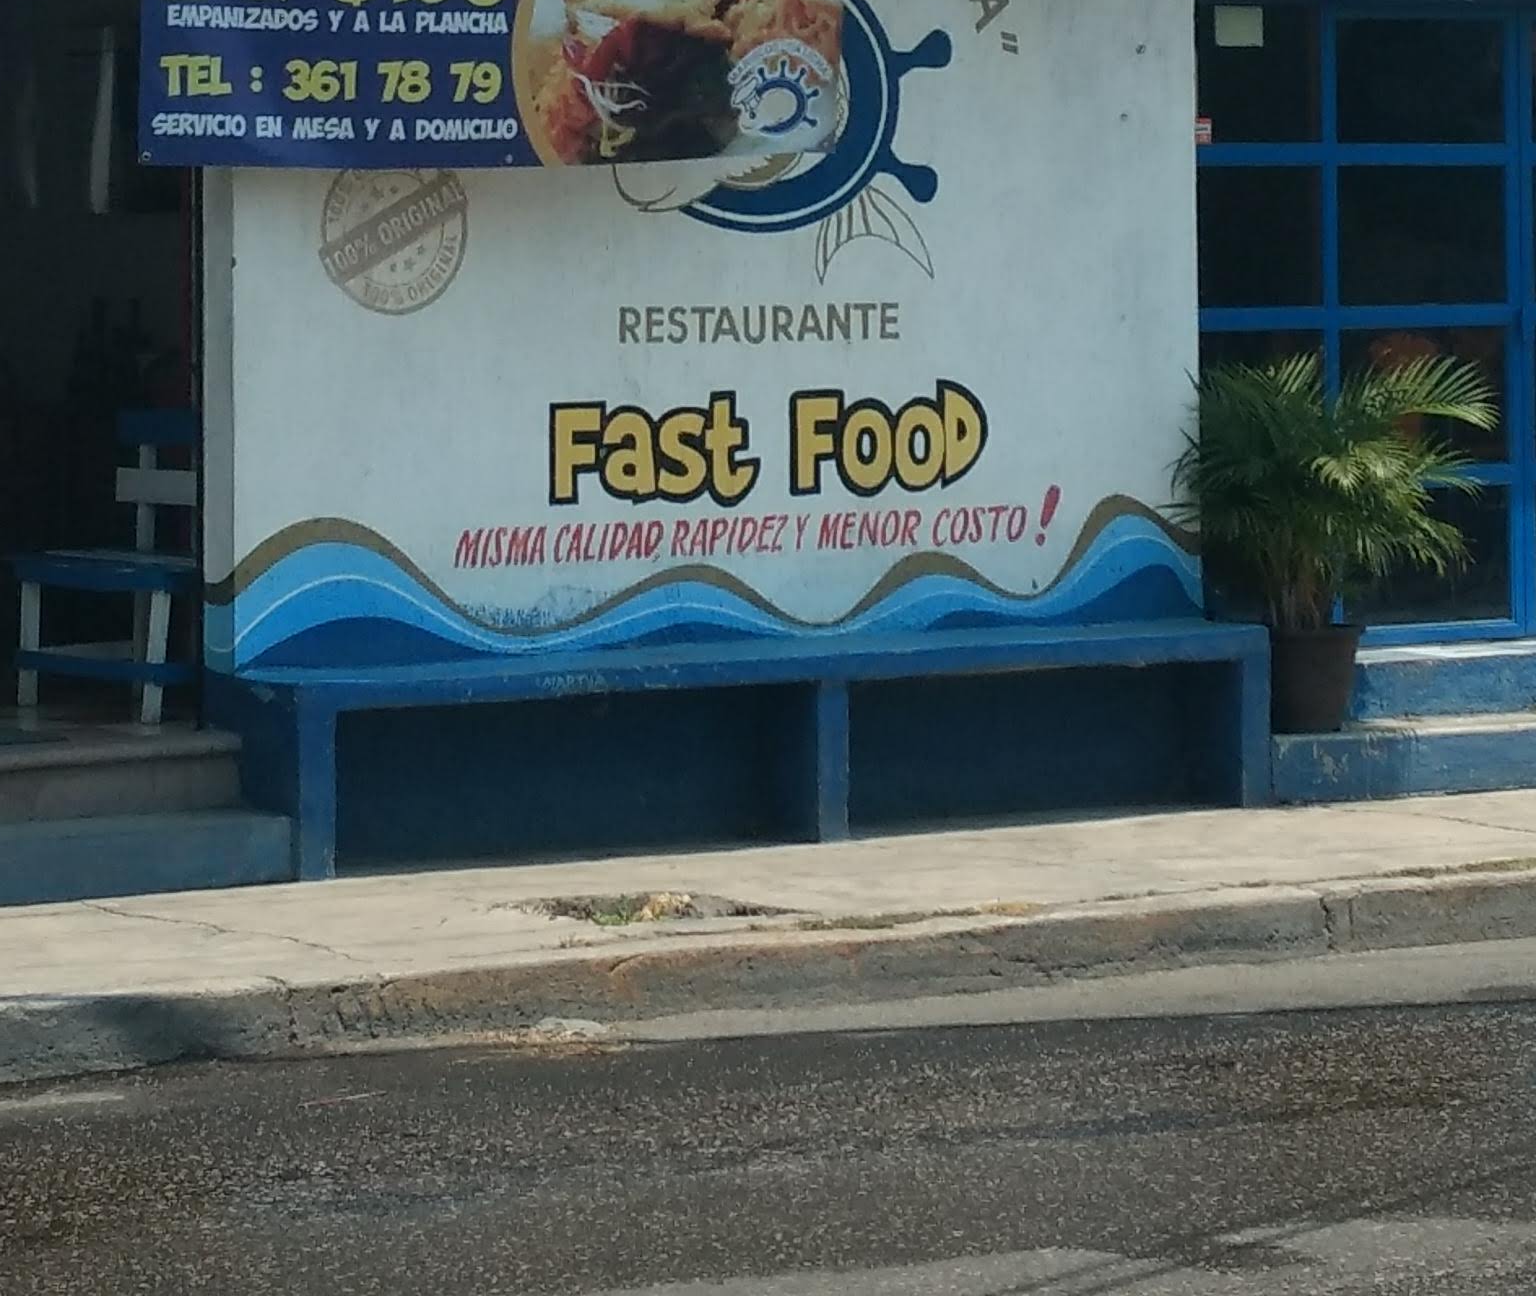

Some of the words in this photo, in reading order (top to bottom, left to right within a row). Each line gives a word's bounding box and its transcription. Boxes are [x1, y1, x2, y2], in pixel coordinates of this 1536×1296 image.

[167, 4, 318, 33] EMPANIZADOS
[327, 9, 344, 32] Y
[353, 9, 370, 33] A
[379, 11, 406, 33] LA
[415, 10, 509, 34] PLANCHA
[160, 53, 232, 97] TEL
[282, 59, 358, 103] 361
[377, 60, 431, 103] 78
[449, 61, 502, 103] 79
[151, 112, 246, 138] SERVICIO
[255, 115, 282, 137] EN
[292, 117, 354, 140] MESA
[364, 118, 381, 139] Y
[389, 119, 406, 140] A
[415, 118, 518, 141] DOMICILIO
[377, 181, 466, 245] ORIGINAL
[618, 303, 899, 344] RESTAURANTE
[549, 391, 760, 506] Fast
[453, 520, 546, 570] MISMA
[671, 514, 788, 557] RAPIDEZ
[794, 514, 811, 552] Y
[817, 509, 922, 551] MENOR
